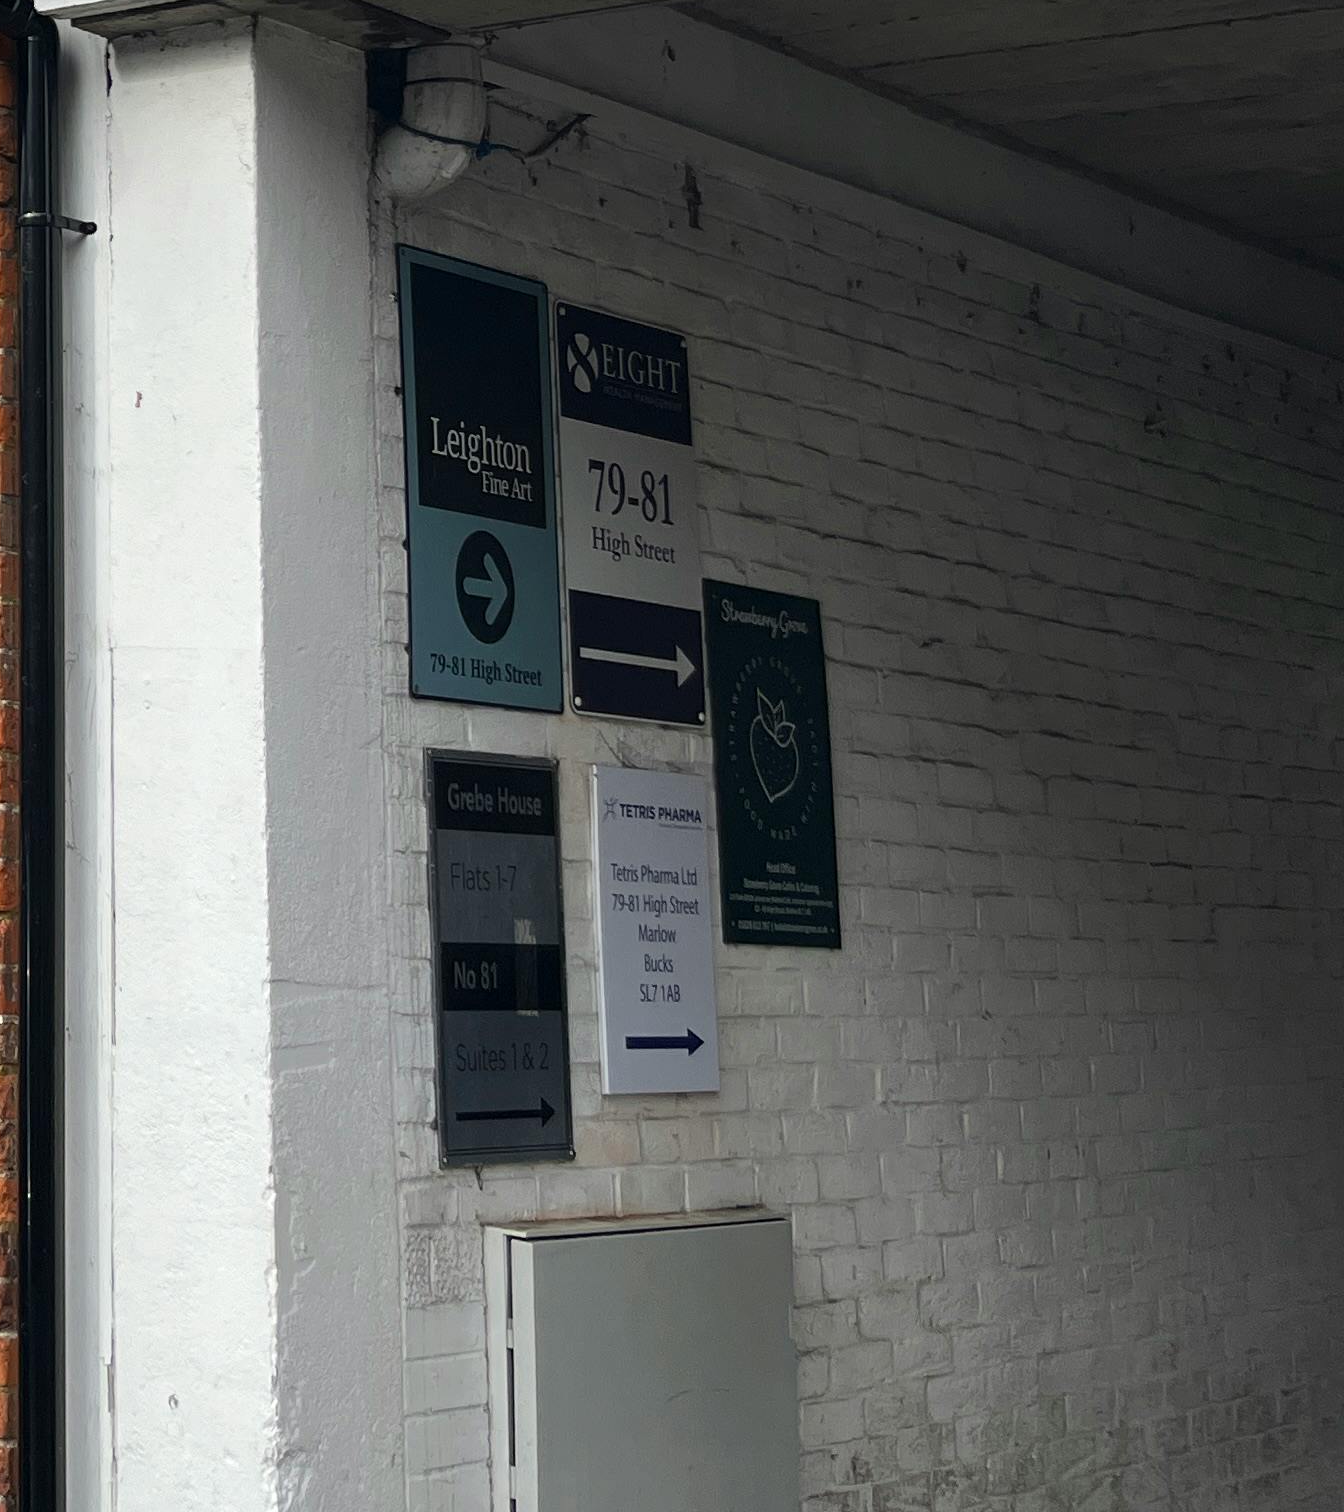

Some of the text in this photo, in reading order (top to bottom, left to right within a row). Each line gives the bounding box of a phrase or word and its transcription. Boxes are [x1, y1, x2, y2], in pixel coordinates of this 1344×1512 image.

[601, 343, 681, 394] EIGHT
[430, 417, 532, 474] Leighton
[482, 472, 533, 503] Fine Art
[588, 459, 675, 526] 79-81
[592, 527, 675, 564] High Street
[430, 653, 542, 688] 79-81 High Street
[447, 782, 542, 816] Grebe House
[620, 803, 702, 823] TETRIS PHARMA
[450, 862, 517, 891] Flats 1-7
[611, 863, 697, 886] Tetris Pharma Ltd
[612, 893, 699, 917] 79-81 High Street
[639, 924, 677, 942] Marlow
[453, 960, 497, 990] No 81
[644, 954, 673, 973] Bucks
[640, 984, 680, 1002] SL7 1AB
[456, 1041, 549, 1072] Suites 1 & 2
